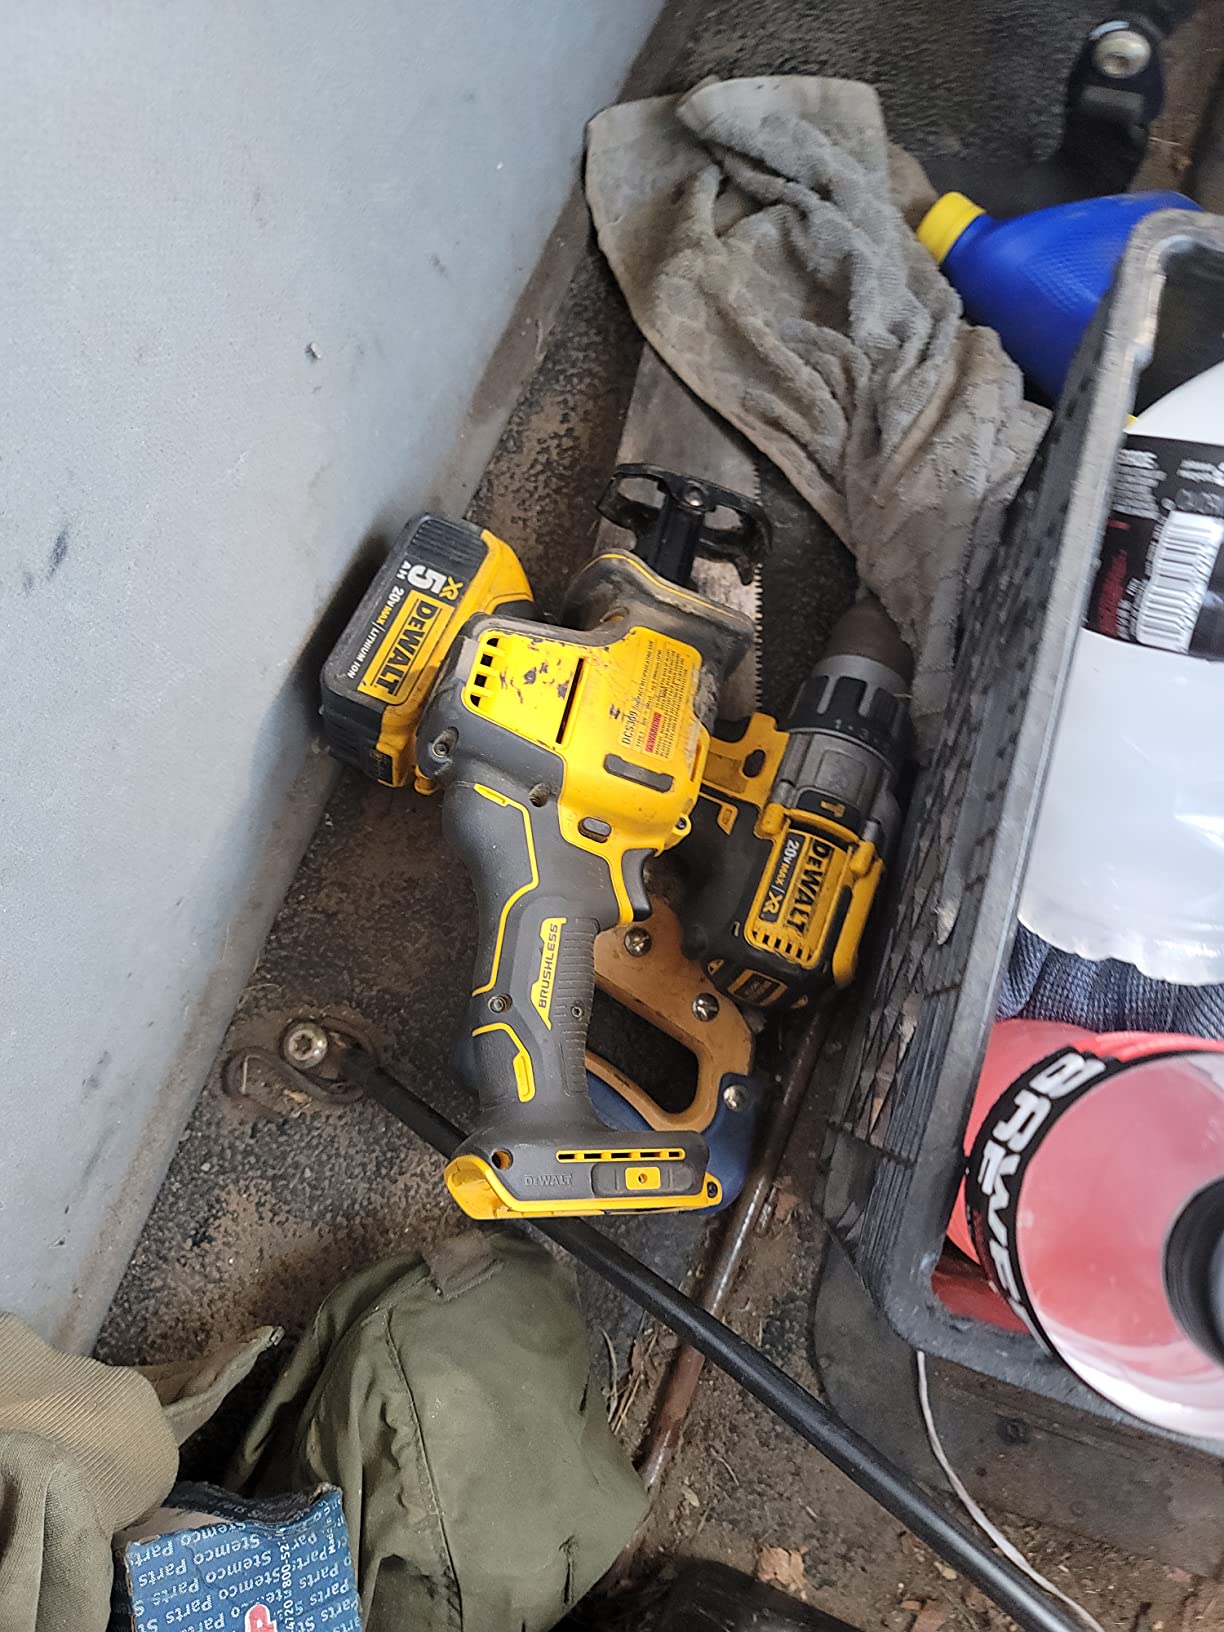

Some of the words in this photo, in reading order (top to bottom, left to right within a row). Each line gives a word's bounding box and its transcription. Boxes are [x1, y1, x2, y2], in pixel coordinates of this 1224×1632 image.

[396, 560, 412, 580] AH
[407, 565, 448, 594] 5
[439, 577, 463, 600] XR
[357, 627, 379, 663] LITHIUM
[347, 663, 361, 679] ION
[763, 891, 783, 914] XR
[538, 923, 558, 1009] BRUSHLESS
[193, 1533, 260, 1565] Stemco
[138, 1558, 187, 1587] Parts
[206, 1550, 272, 1584] Stemco
[299, 1562, 340, 1590] Parts
[152, 1577, 200, 1606] Parts
[219, 1567, 280, 1600] Stemco
[310, 1578, 350, 1606] Parts
[165, 1594, 213, 1624] Parts
